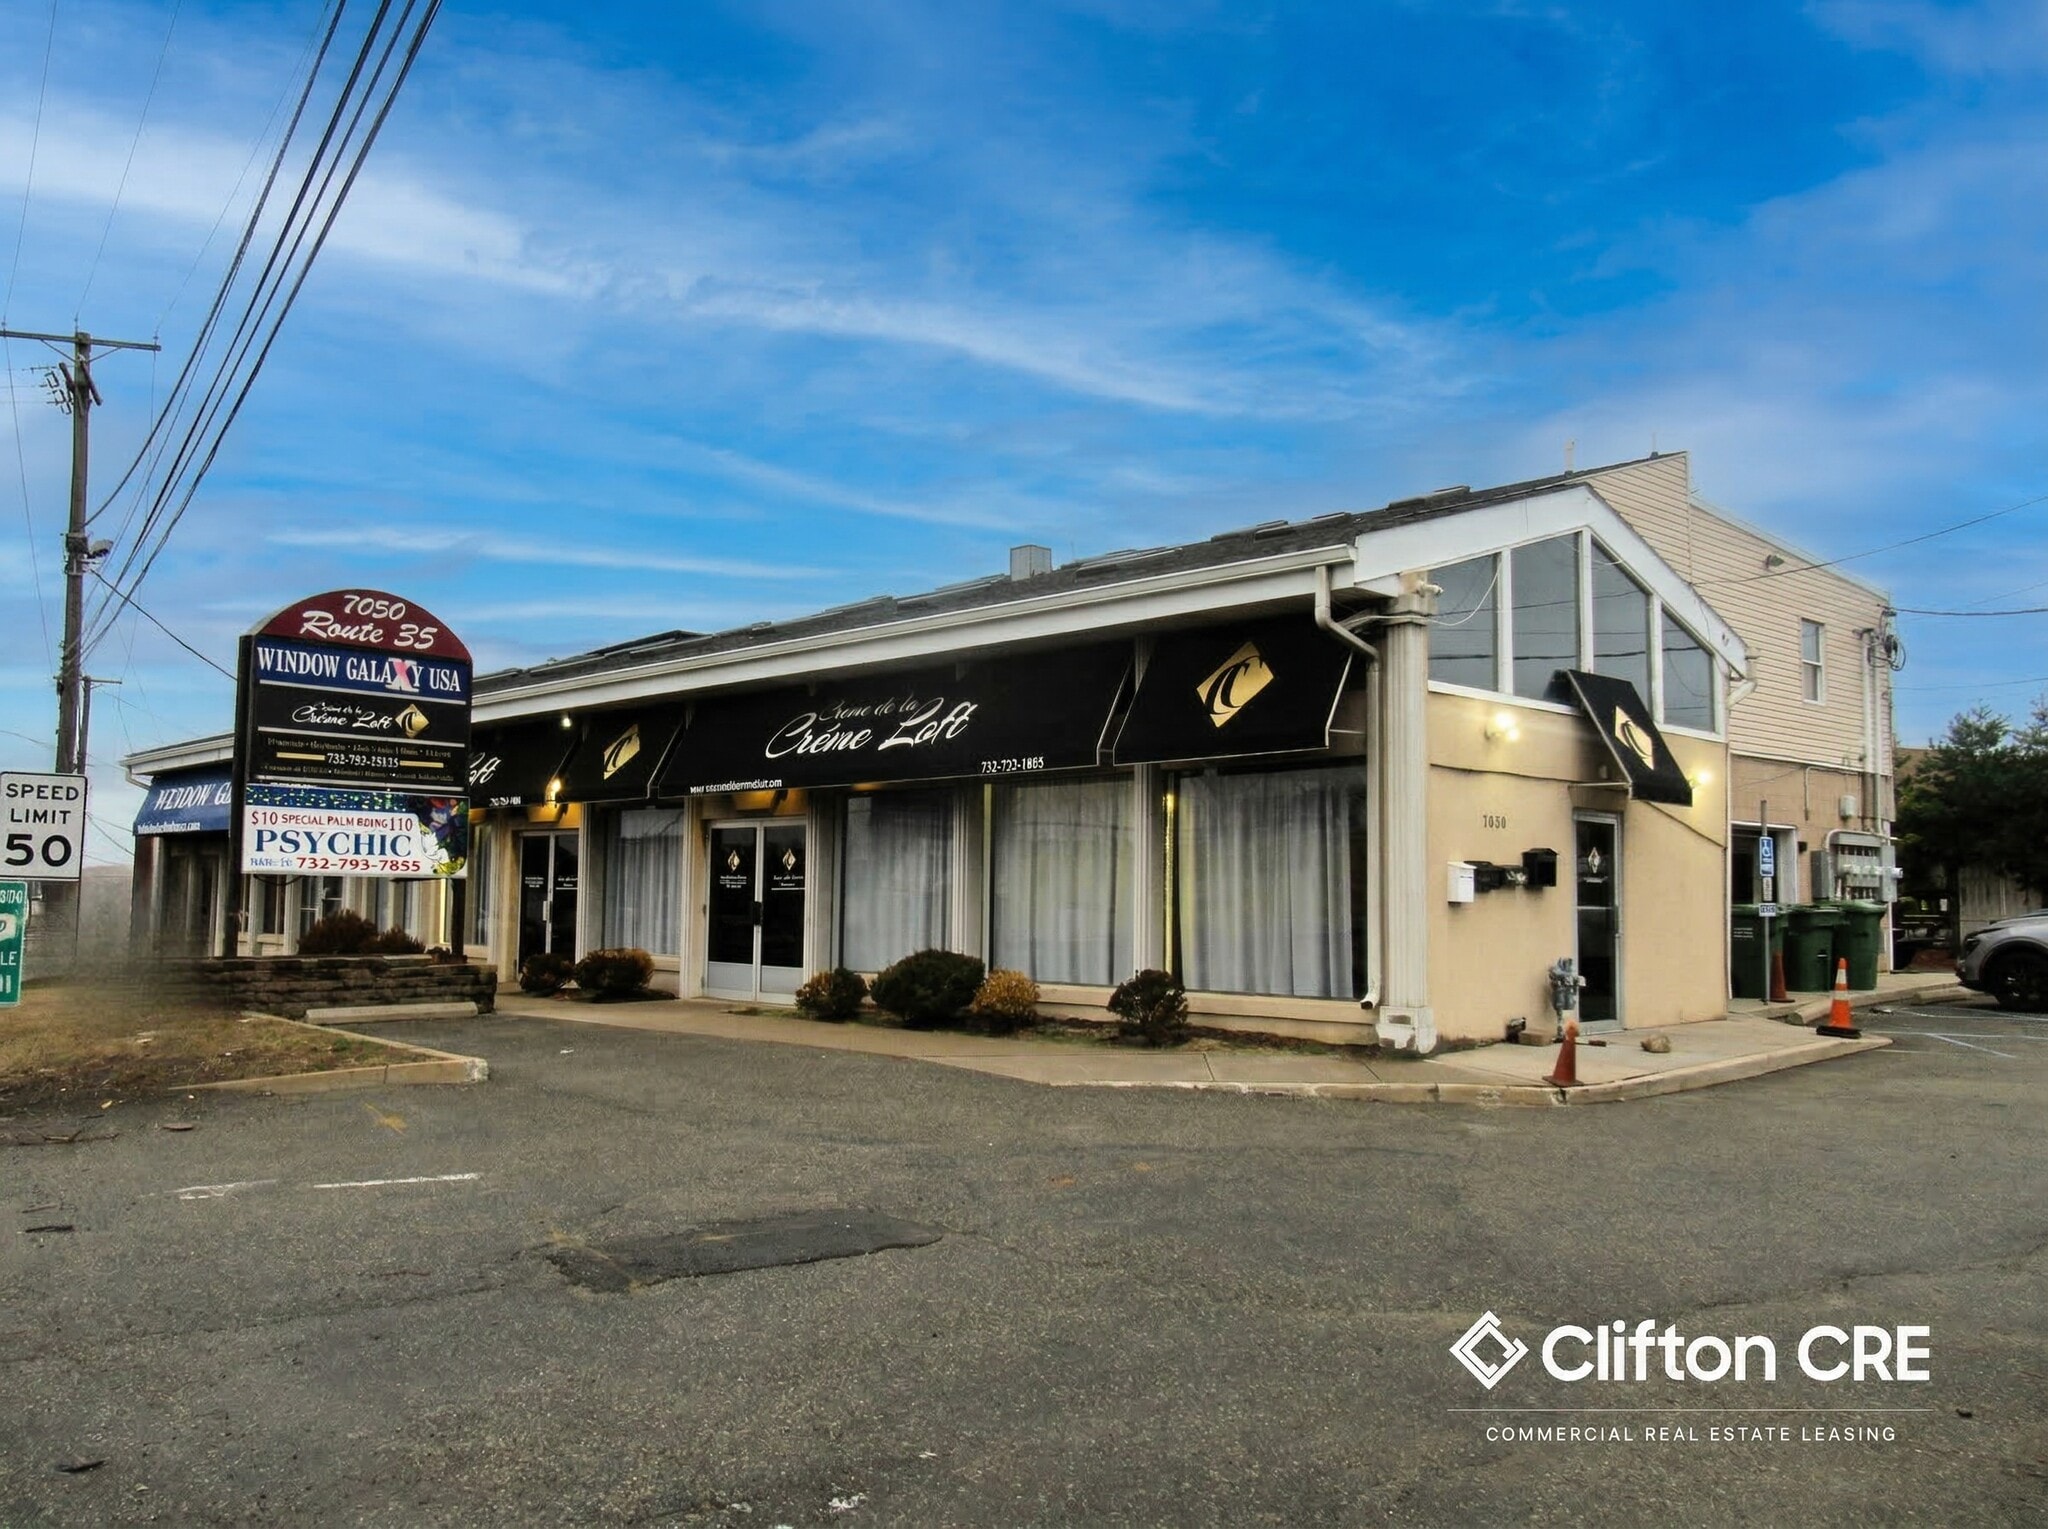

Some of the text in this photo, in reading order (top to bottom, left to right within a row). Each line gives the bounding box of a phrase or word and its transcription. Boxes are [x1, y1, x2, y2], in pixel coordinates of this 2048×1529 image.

[344, 594, 406, 620] 7050
[300, 610, 438, 650] Route 35
[257, 647, 462, 693] WINDOW GALAXY USA
[877, 697, 979, 751] Loft
[6, 783, 79, 801] SPEED
[10, 808, 71, 824] LIMIT
[251, 811, 278, 825] $10
[281, 814, 325, 826] SPECIAL
[327, 815, 354, 827] PALM
[5, 833, 72, 867] 50
[255, 829, 412, 857] PSYCHIC
[296, 857, 421, 872] 732-793-7855
